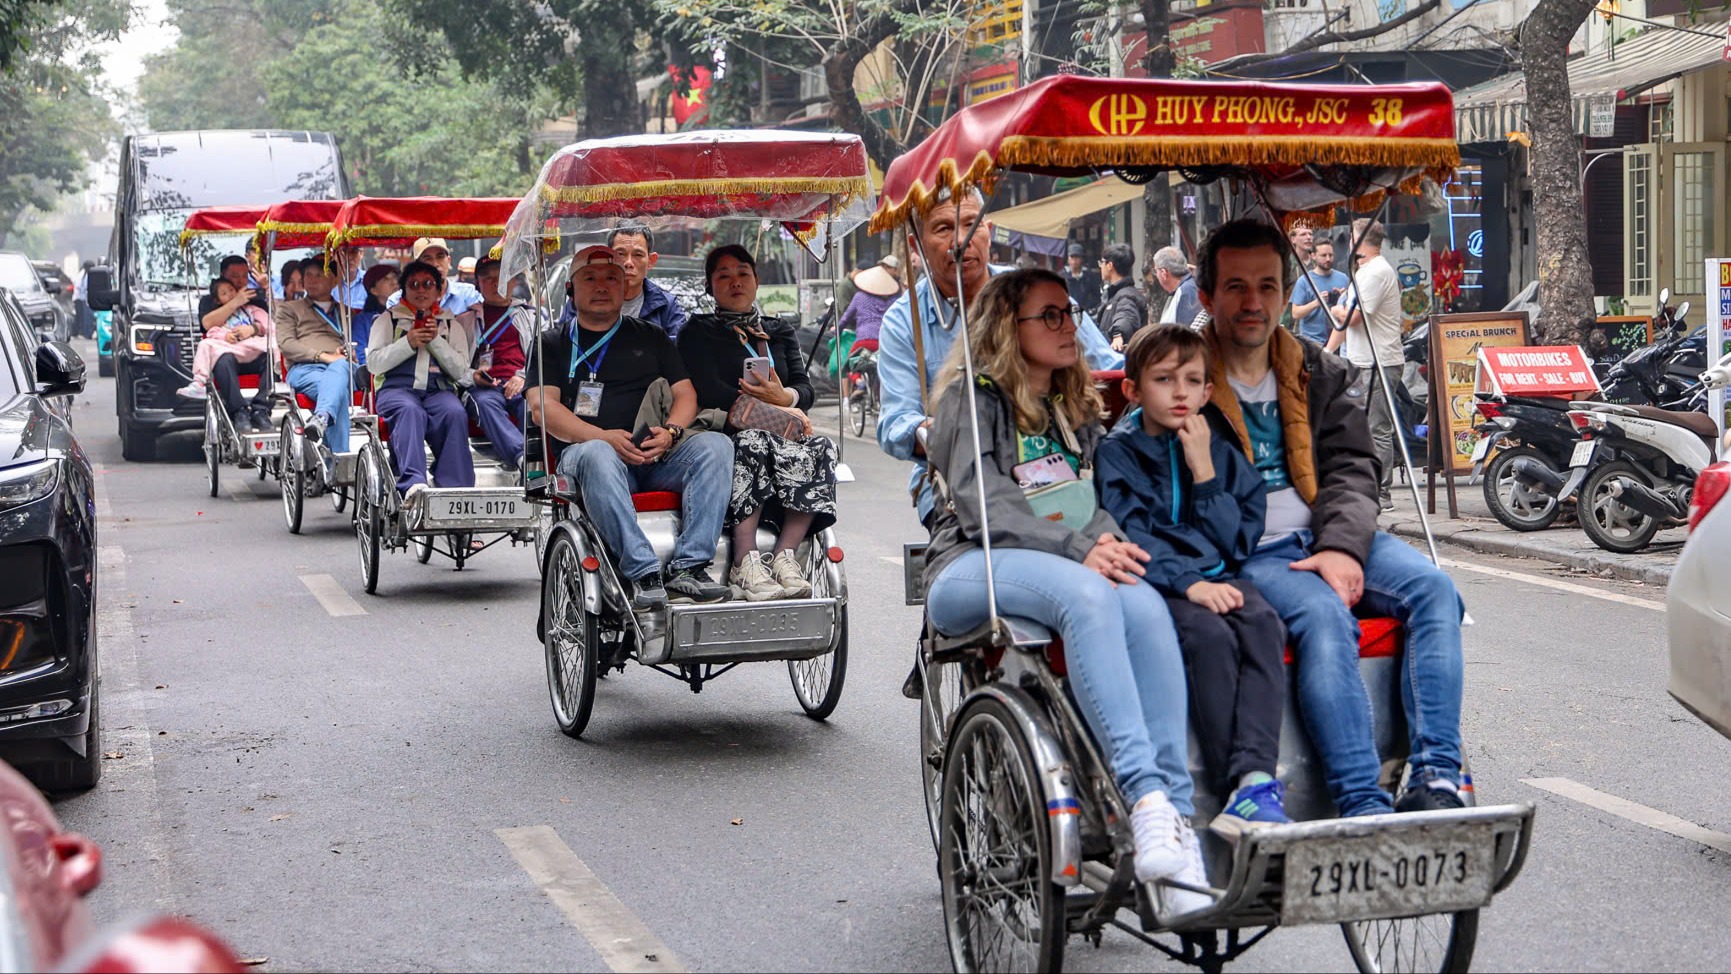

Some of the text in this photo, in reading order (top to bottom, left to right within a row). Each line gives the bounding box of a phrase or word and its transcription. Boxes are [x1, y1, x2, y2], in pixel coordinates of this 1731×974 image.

[1154, 96, 1208, 125] HUY
[1368, 98, 1404, 126] 38
[1483, 327, 1517, 337] BRUNCH
[1497, 352, 1573, 367] MOTORBIKES
[1498, 371, 1588, 385] FOR RENT SALE BUY
[449, 501, 516, 514] 29XL-0170
[1310, 851, 1467, 896] 29XL-0073
